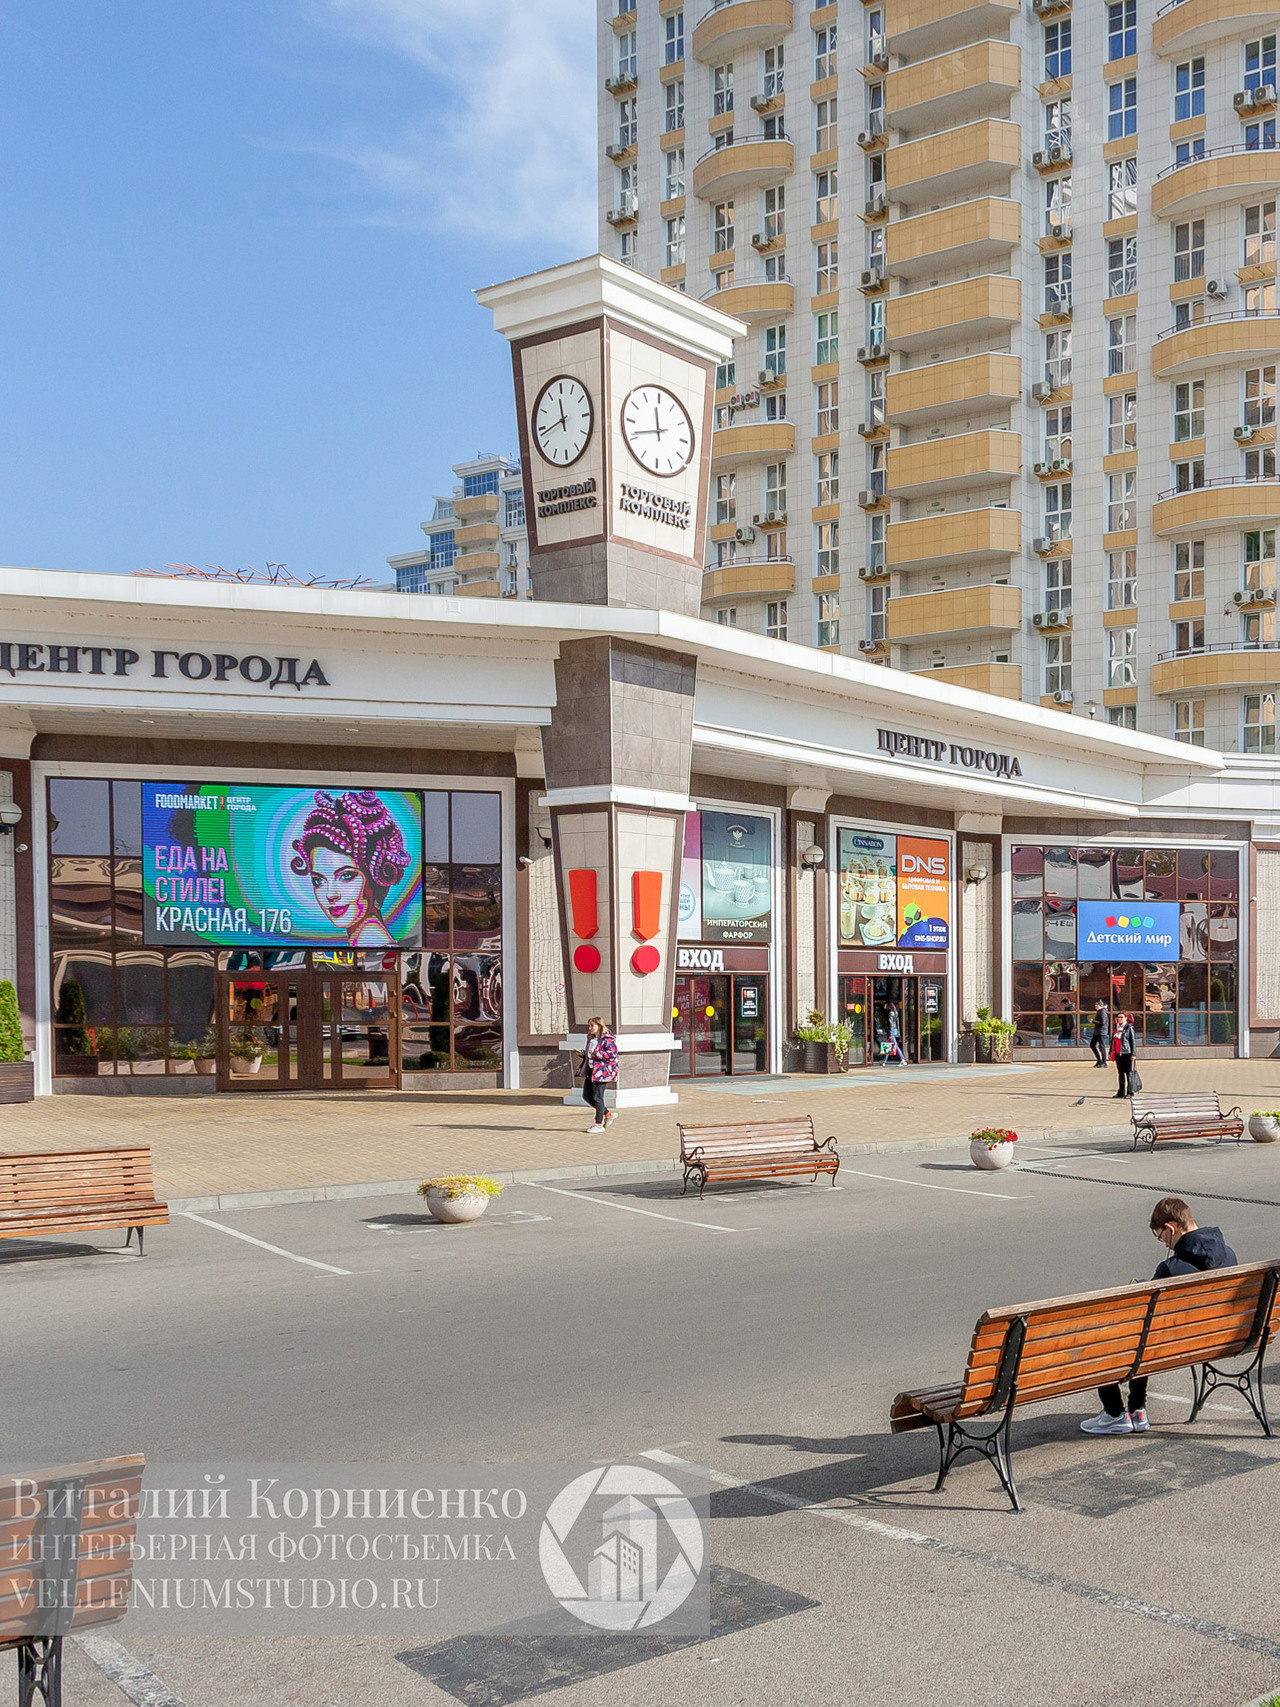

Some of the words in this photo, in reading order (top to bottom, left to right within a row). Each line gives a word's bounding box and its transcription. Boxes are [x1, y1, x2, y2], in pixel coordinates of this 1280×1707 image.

[537, 478, 597, 502] ТОРГОВЫЙ
[620, 483, 692, 514] ТОРГОВЫЙ
[538, 496, 598, 518] КОМПЛЕКС
[620, 498, 690, 530] КОМПЛЕКС
[150, 650, 331, 691] ГОРОДА
[876, 728, 947, 761] ЦЕНТР
[950, 744, 1023, 779] ГОРОДА
[155, 794, 218, 810] FOODMARKET
[155, 845, 197, 874] ЕДА
[202, 847, 228, 872] НА
[901, 854, 946, 876] DNS
[156, 876, 225, 903] СТИЛЕ!
[156, 906, 252, 934] КРАСНАЯ,
[258, 908, 292, 933] 176
[706, 920, 768, 929] ИМПЕРАТОРСКИЙ
[722, 931, 754, 939] ФАРФОР
[1086, 930, 1142, 944] Детский
[1145, 933, 1172, 948] мир
[678, 949, 724, 971] ВХОД
[878, 954, 913, 974] ВХОД
